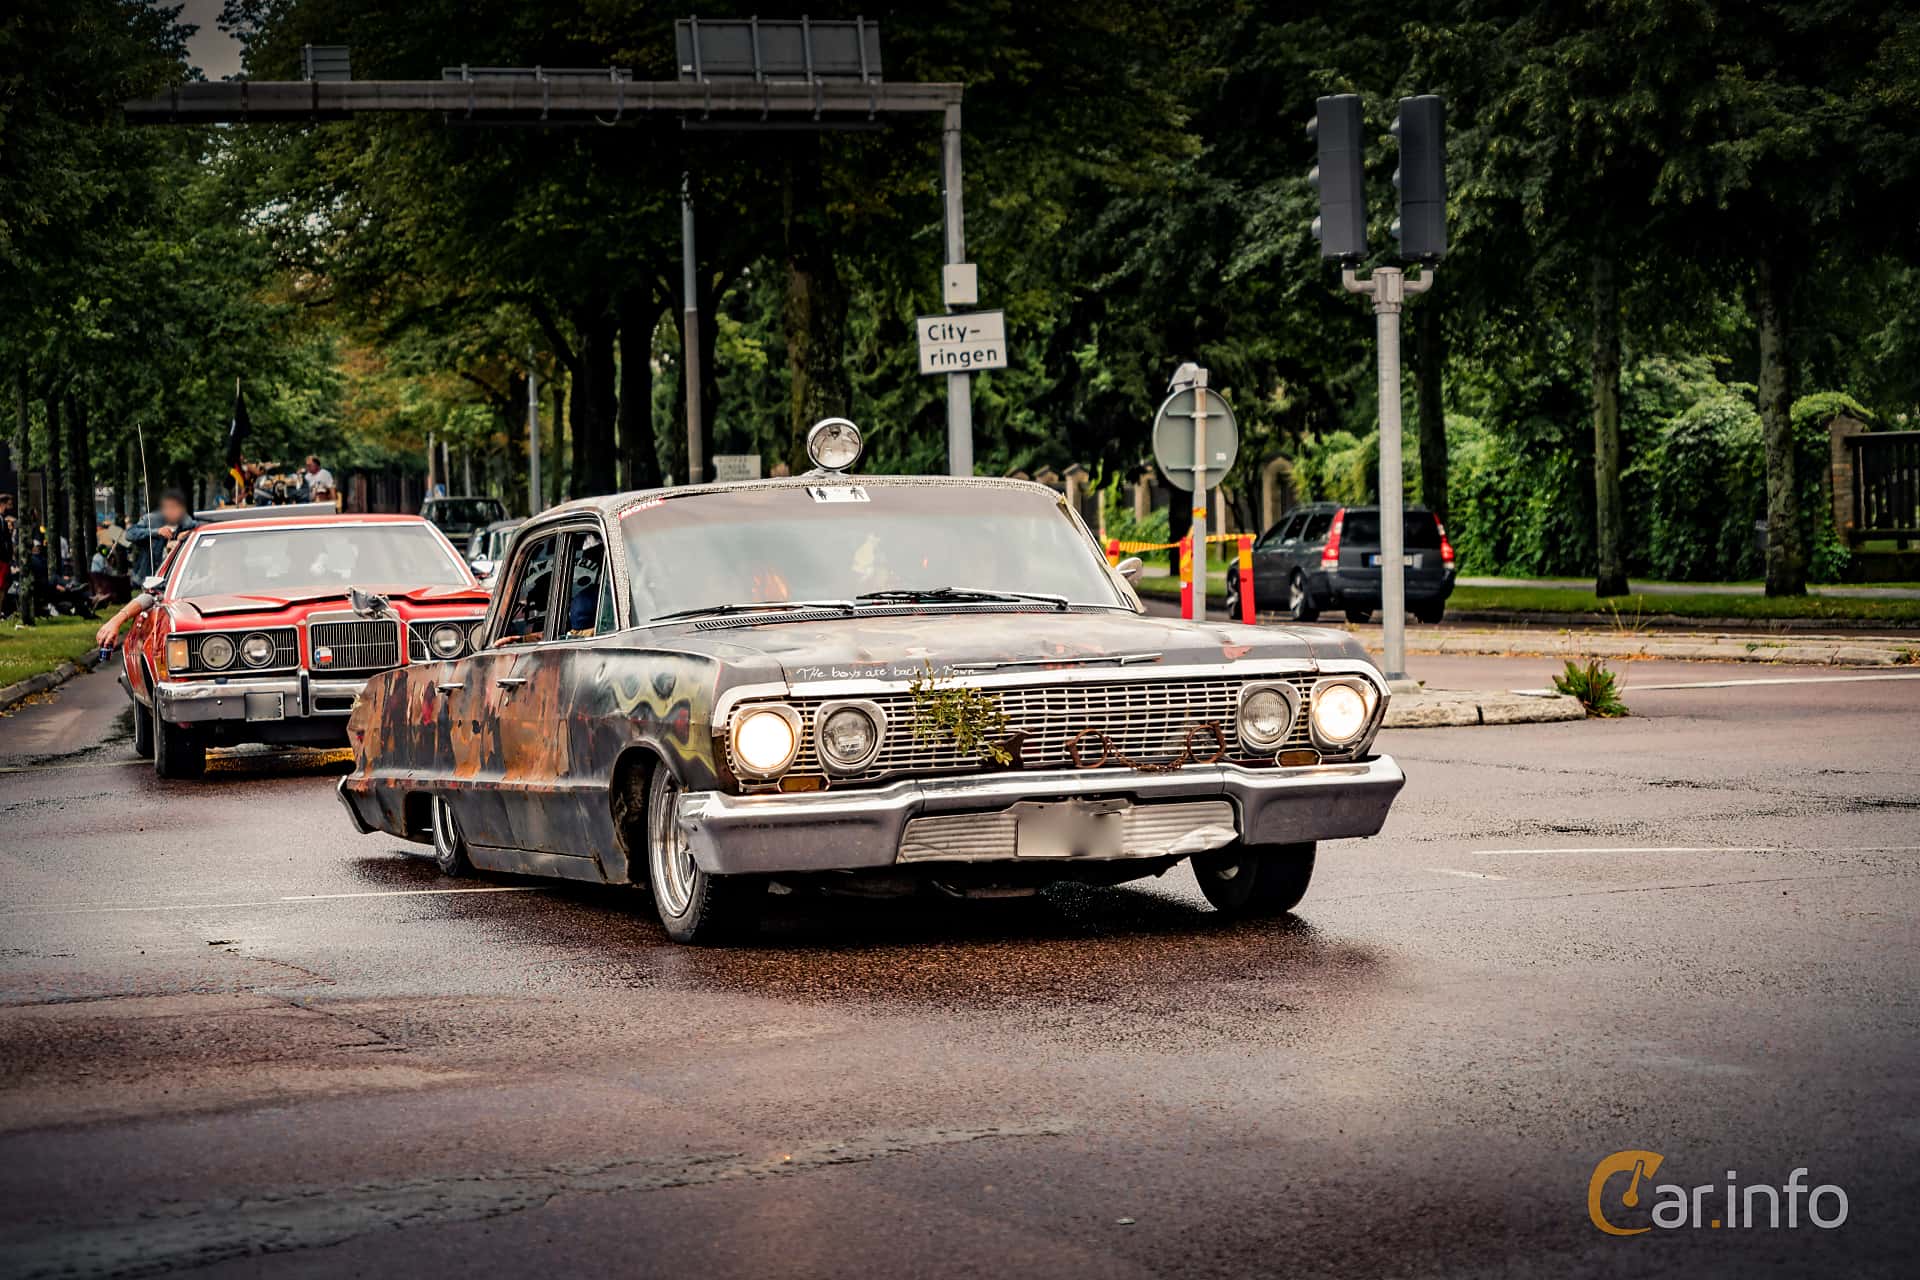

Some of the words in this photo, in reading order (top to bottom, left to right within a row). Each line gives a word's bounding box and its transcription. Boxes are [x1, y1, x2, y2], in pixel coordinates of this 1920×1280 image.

[928, 323, 981, 343] City-
[930, 348, 998, 367] ringen
[831, 666, 861, 680] boys
[865, 668, 888, 678] are
